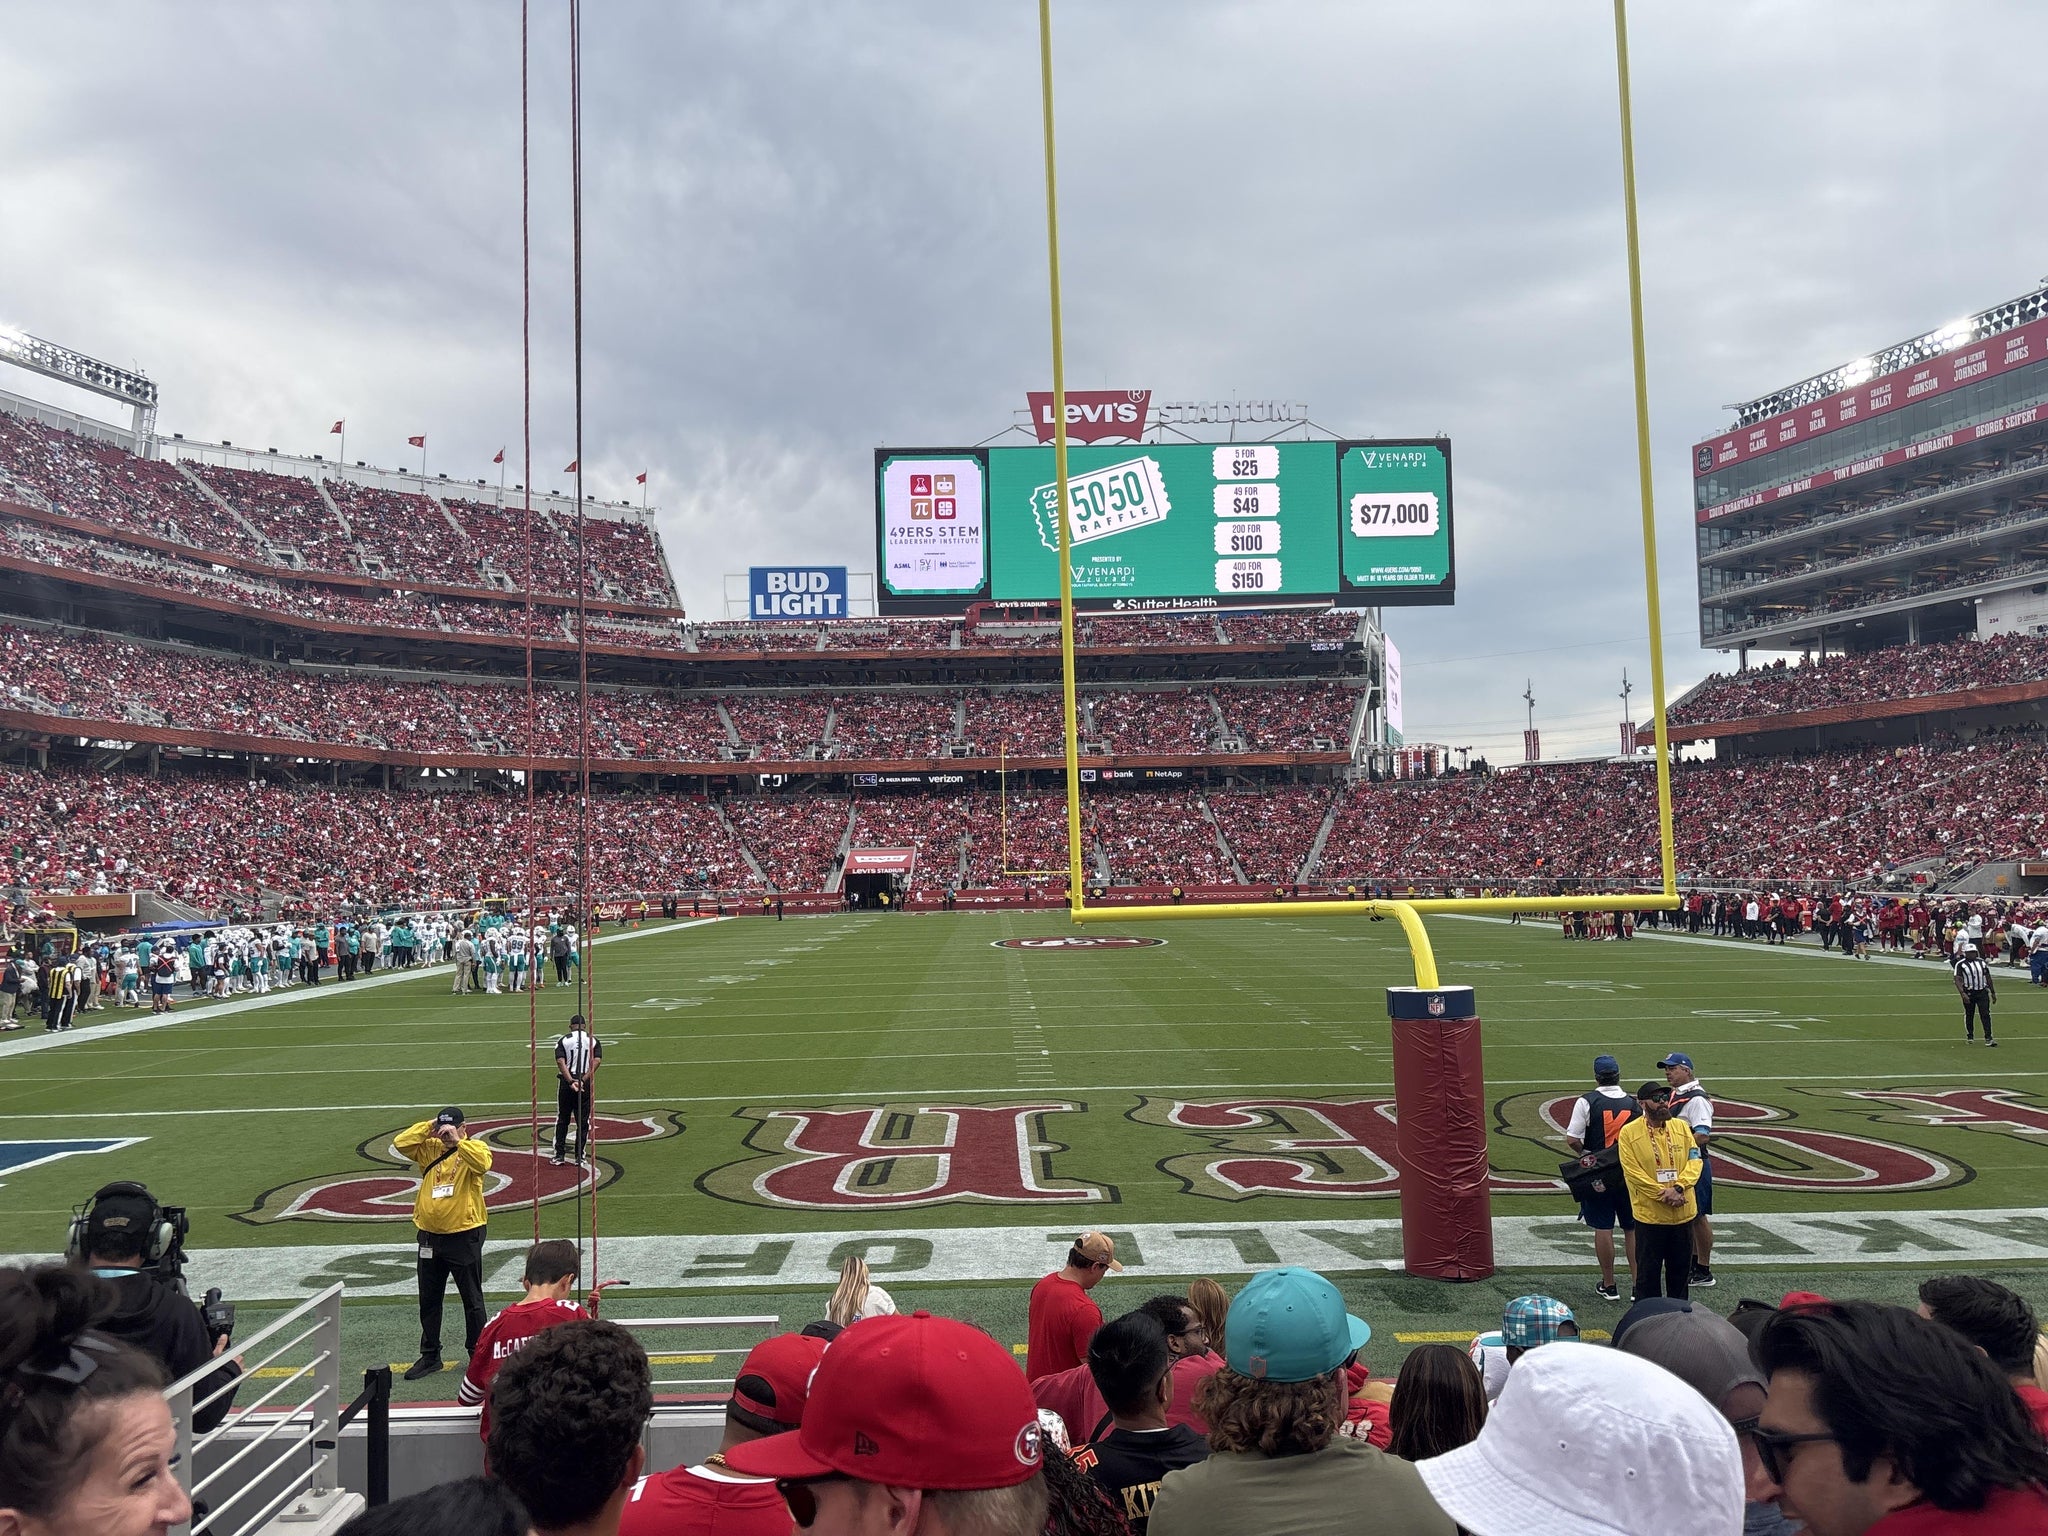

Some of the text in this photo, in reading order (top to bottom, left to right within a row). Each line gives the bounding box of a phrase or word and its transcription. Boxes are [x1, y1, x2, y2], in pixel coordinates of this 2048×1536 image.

[2006, 336, 2024, 350] BRENT
[1953, 357, 1967, 369] JOHN
[2004, 346, 2029, 365] JONES
[1954, 360, 1987, 382] JOHNSON
[1870, 384, 1891, 398] CHARLES
[1906, 377, 1938, 398] JOHNSON
[1870, 393, 1892, 410] HALEY
[1159, 400, 1297, 425] STADIUM
[1839, 406, 1857, 421] GORE
[1809, 417, 1826, 432] DEAN
[1975, 408, 2037, 438] GEORGE SEIFERT
[1749, 438, 1767, 452] CLARK
[1905, 435, 1953, 459] VIC MORABITO
[1235, 449, 1255, 458] 5 FOR
[1378, 452, 1427, 461] VENARDI
[1232, 459, 1258, 476] $25
[1378, 460, 1427, 468] zurada
[1833, 455, 1884, 481] TONY MORABITO
[1234, 486, 1258, 496] 49 FOR
[1776, 485, 1792, 498] JOHN
[1233, 497, 1259, 514] $49
[1079, 506, 1149, 533] RAFFLE
[1360, 503, 1429, 526] $77,000
[890, 526, 979, 538] 49ERS STEM
[1232, 524, 1261, 533] 200 FOR
[1231, 534, 1263, 552] $100
[1087, 566, 1135, 576] VENARDI
[1232, 562, 1262, 571] 400 FOR
[767, 572, 830, 593] BUD
[1231, 572, 1263, 589] $150
[1127, 597, 1217, 610] Sutter Health
[928, 774, 963, 783] verizon
[1114, 770, 1134, 778] bank
[511, 940, 524, 950] 89
[682, 1237, 934, 1278] OF
